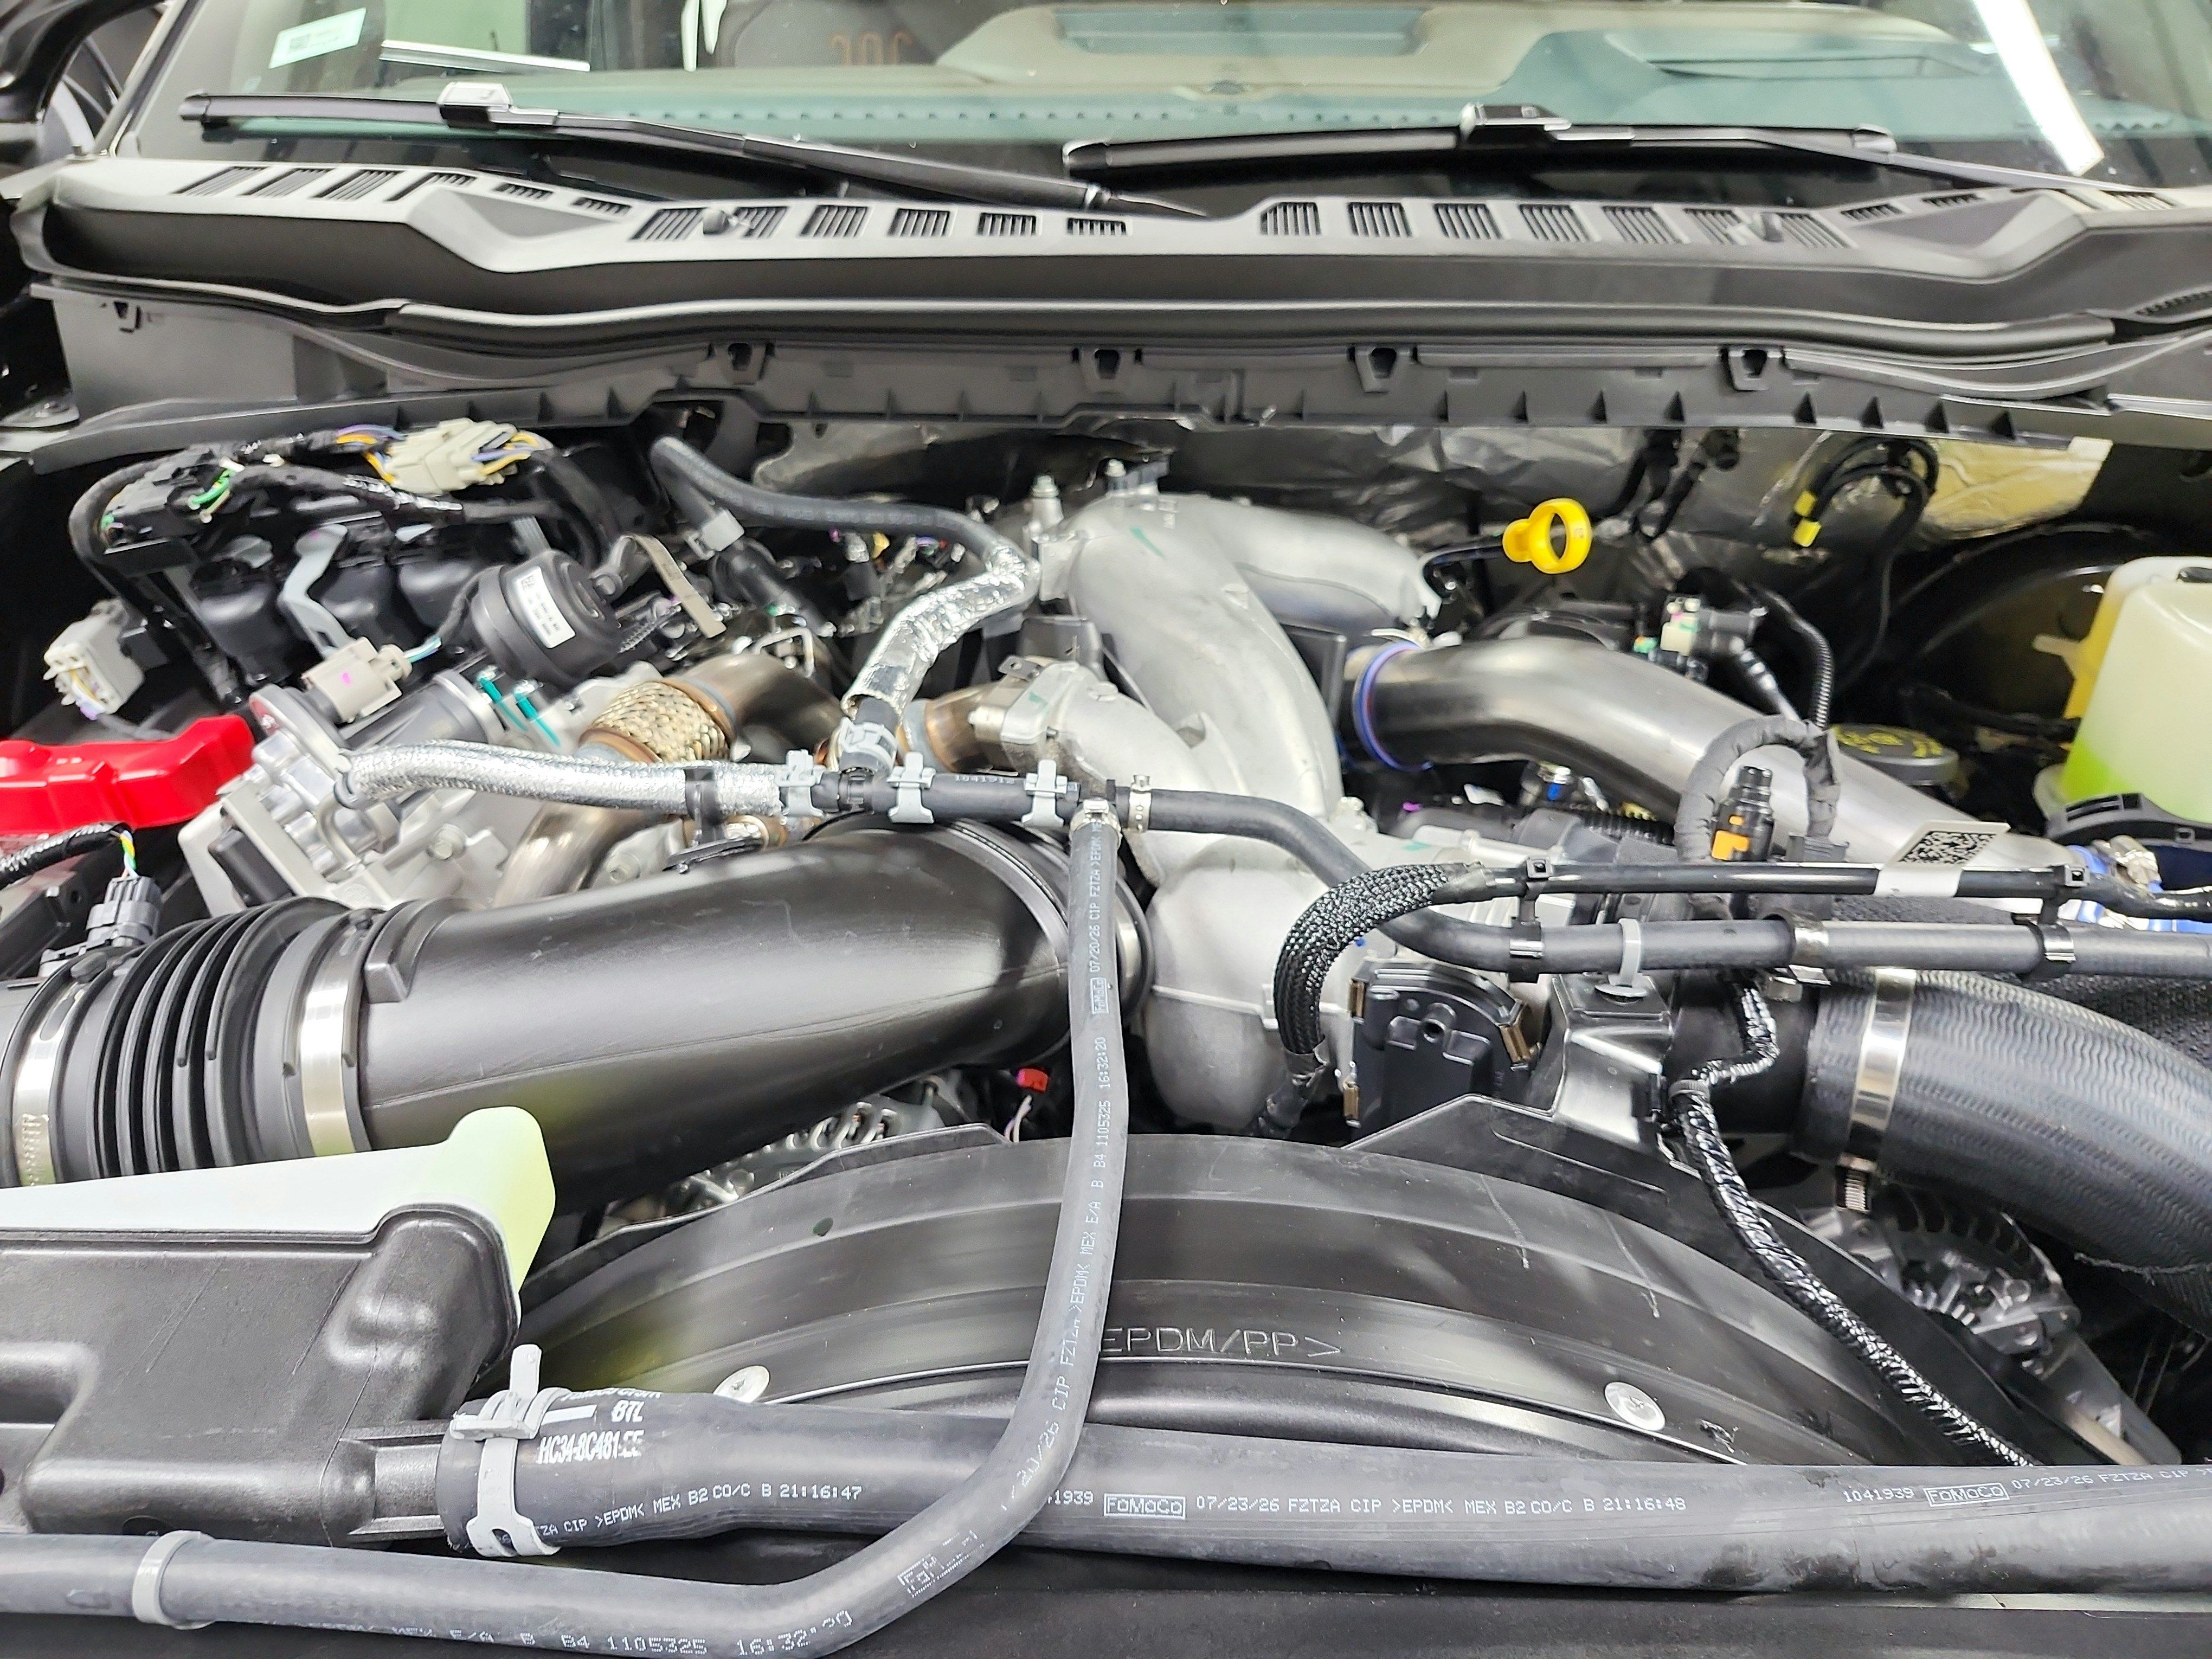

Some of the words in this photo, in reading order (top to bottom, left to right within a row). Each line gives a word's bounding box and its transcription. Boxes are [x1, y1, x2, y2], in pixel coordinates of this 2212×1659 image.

[1091, 822, 1103, 833] ME
[1089, 902, 1101, 921] CIP
[1094, 1037, 1111, 1089] 16:32:20
[1096, 1100, 1110, 1146] 1105325
[1093, 1154, 1107, 1167] B4
[1091, 1179, 1104, 1188] B
[1085, 1200, 1102, 1224] E/A
[1079, 1231, 1097, 1255] MEX
[1052, 1375, 1070, 1411] CIP
[1843, 1488, 1915, 1502] 1041939
[2011, 1475, 2094, 1489] 07/23/26
[2159, 1470, 2189, 1478] CIP
[563, 1518, 588, 1533] CIP
[653, 1493, 681, 1514] MEX
[688, 1487, 709, 1505] B2
[761, 1483, 772, 1497] B
[779, 1483, 863, 1500] 21:16:47
[1049, 1489, 1094, 1506] 1939
[1196, 1495, 1280, 1512] 07/23/26
[1288, 1498, 1341, 1513] FZTZA
[1351, 1499, 1382, 1513] CIP
[1464, 1500, 1496, 1514] MEX
[1504, 1500, 1526, 1514] B2
[1583, 1498, 1594, 1512] B
[1602, 1496, 1687, 1511] 21:16:48
[561, 1634, 590, 1649] B4
[607, 1636, 708, 1655] 1105325
